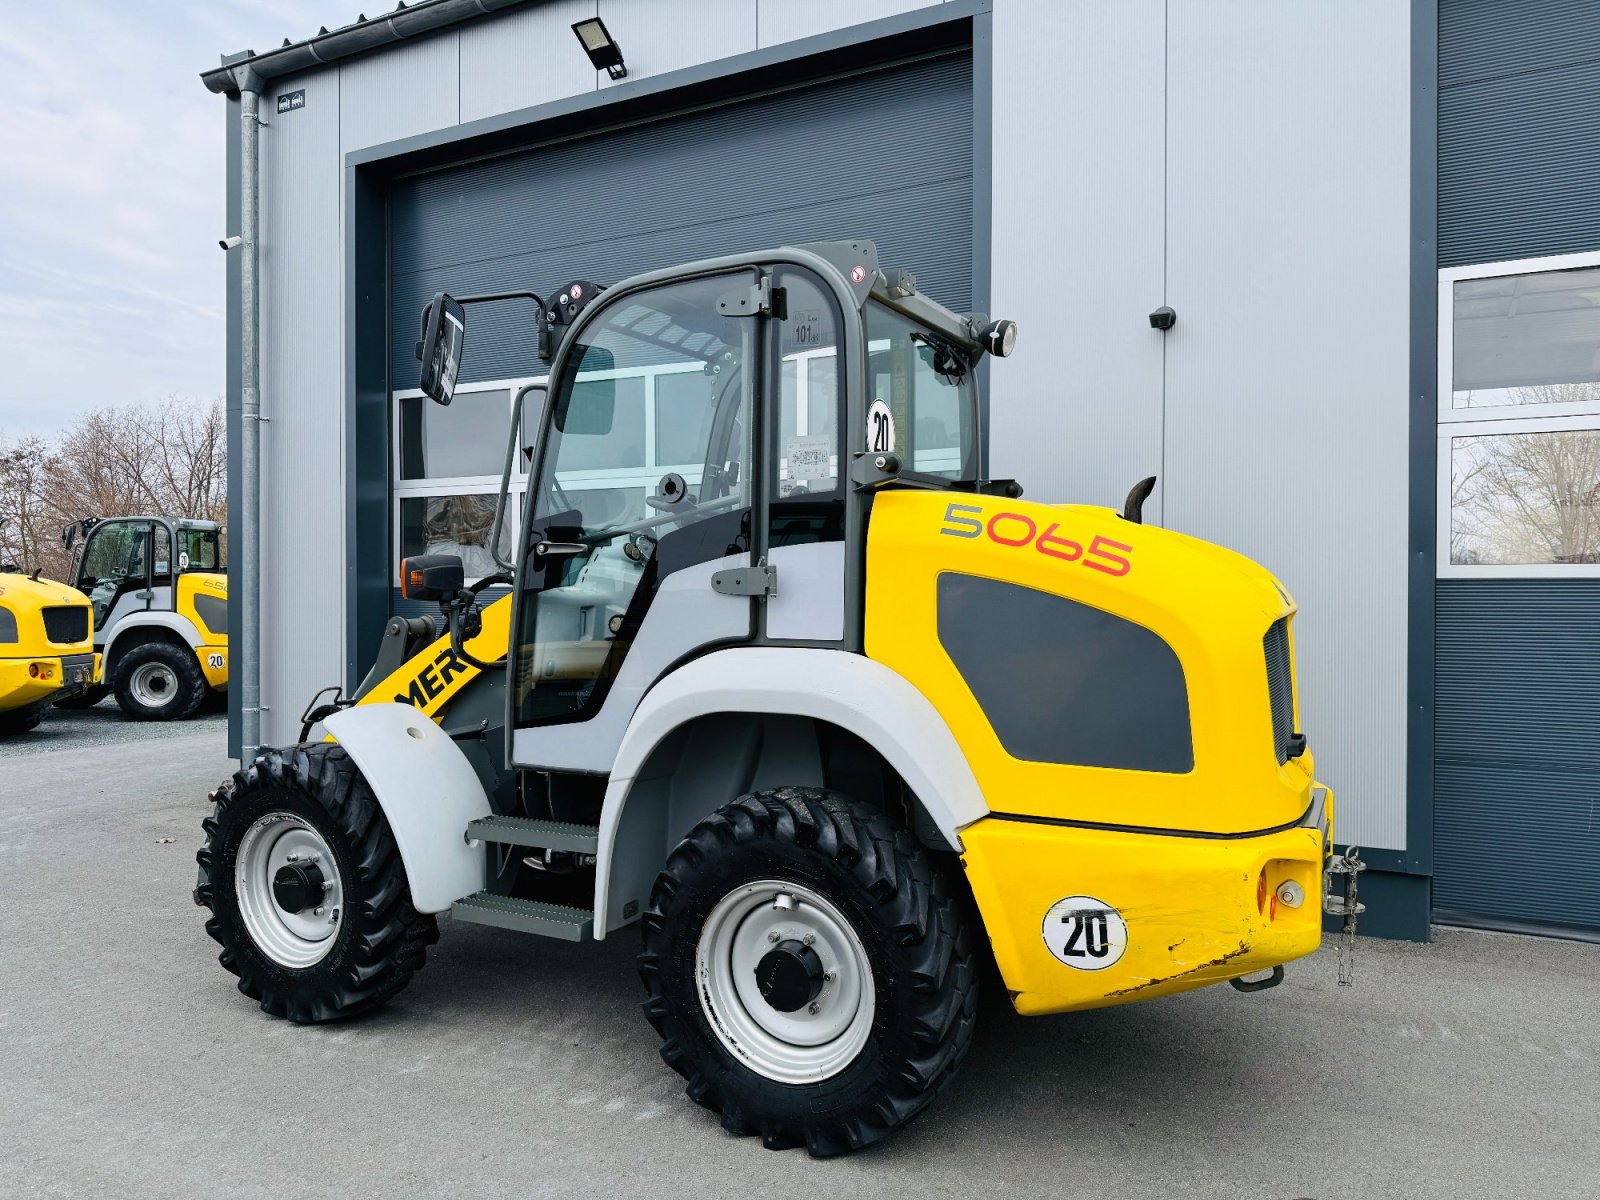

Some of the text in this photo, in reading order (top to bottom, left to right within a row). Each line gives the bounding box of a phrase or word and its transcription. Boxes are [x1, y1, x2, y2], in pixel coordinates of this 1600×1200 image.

[796, 325, 811, 343] 101
[873, 411, 889, 452] 20
[940, 503, 1133, 577] 5065
[210, 655, 223, 667] 20
[393, 647, 469, 709] MER
[1061, 911, 1109, 958] 20
